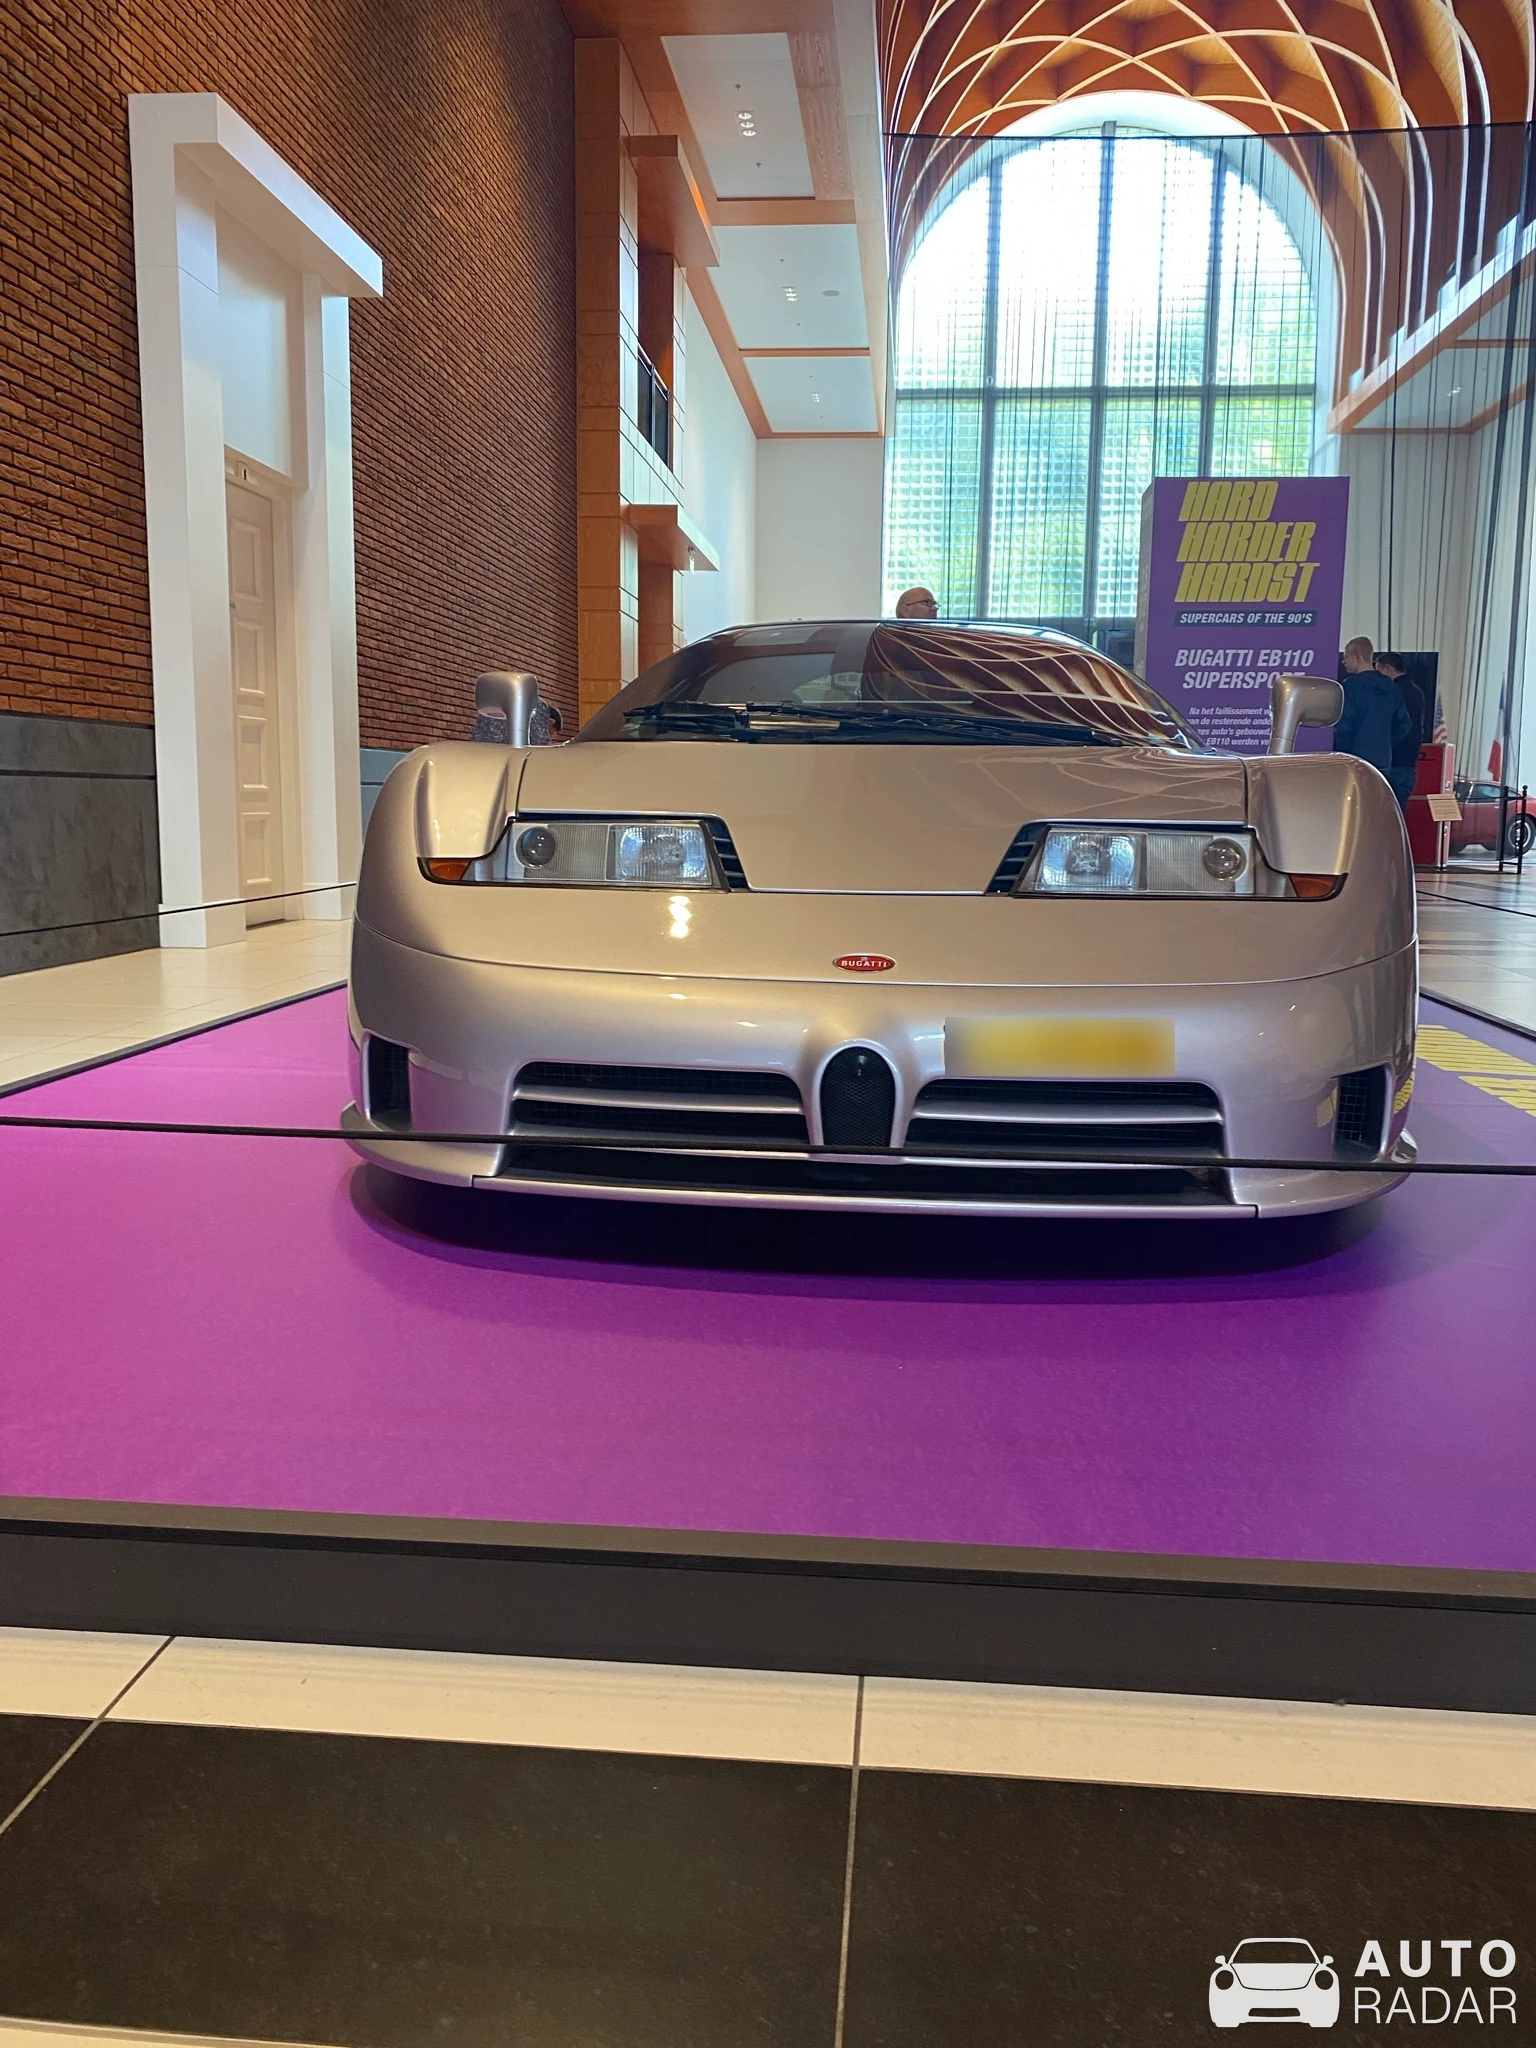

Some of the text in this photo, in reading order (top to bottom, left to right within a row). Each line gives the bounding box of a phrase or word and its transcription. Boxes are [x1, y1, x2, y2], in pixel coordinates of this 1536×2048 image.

[1178, 481, 1279, 521] HARD
[1176, 522, 1316, 562] HARDER
[1174, 562, 1320, 602] HARDST
[1180, 613, 1313, 624] SUPERCARS OF THE 90'S
[1174, 649, 1315, 667] BUGATTI EB110
[1182, 671, 1306, 689] SUPERSPO
[1189, 707, 1200, 715] Na
[1201, 707, 1214, 715] het
[1215, 707, 1263, 715] faillissement
[1200, 717, 1210, 725] de
[1211, 717, 1251, 725] resterende
[1207, 737, 1230, 746] EB110
[1231, 738, 1259, 746] werden
[841, 960, 887, 968] BUGATTI
